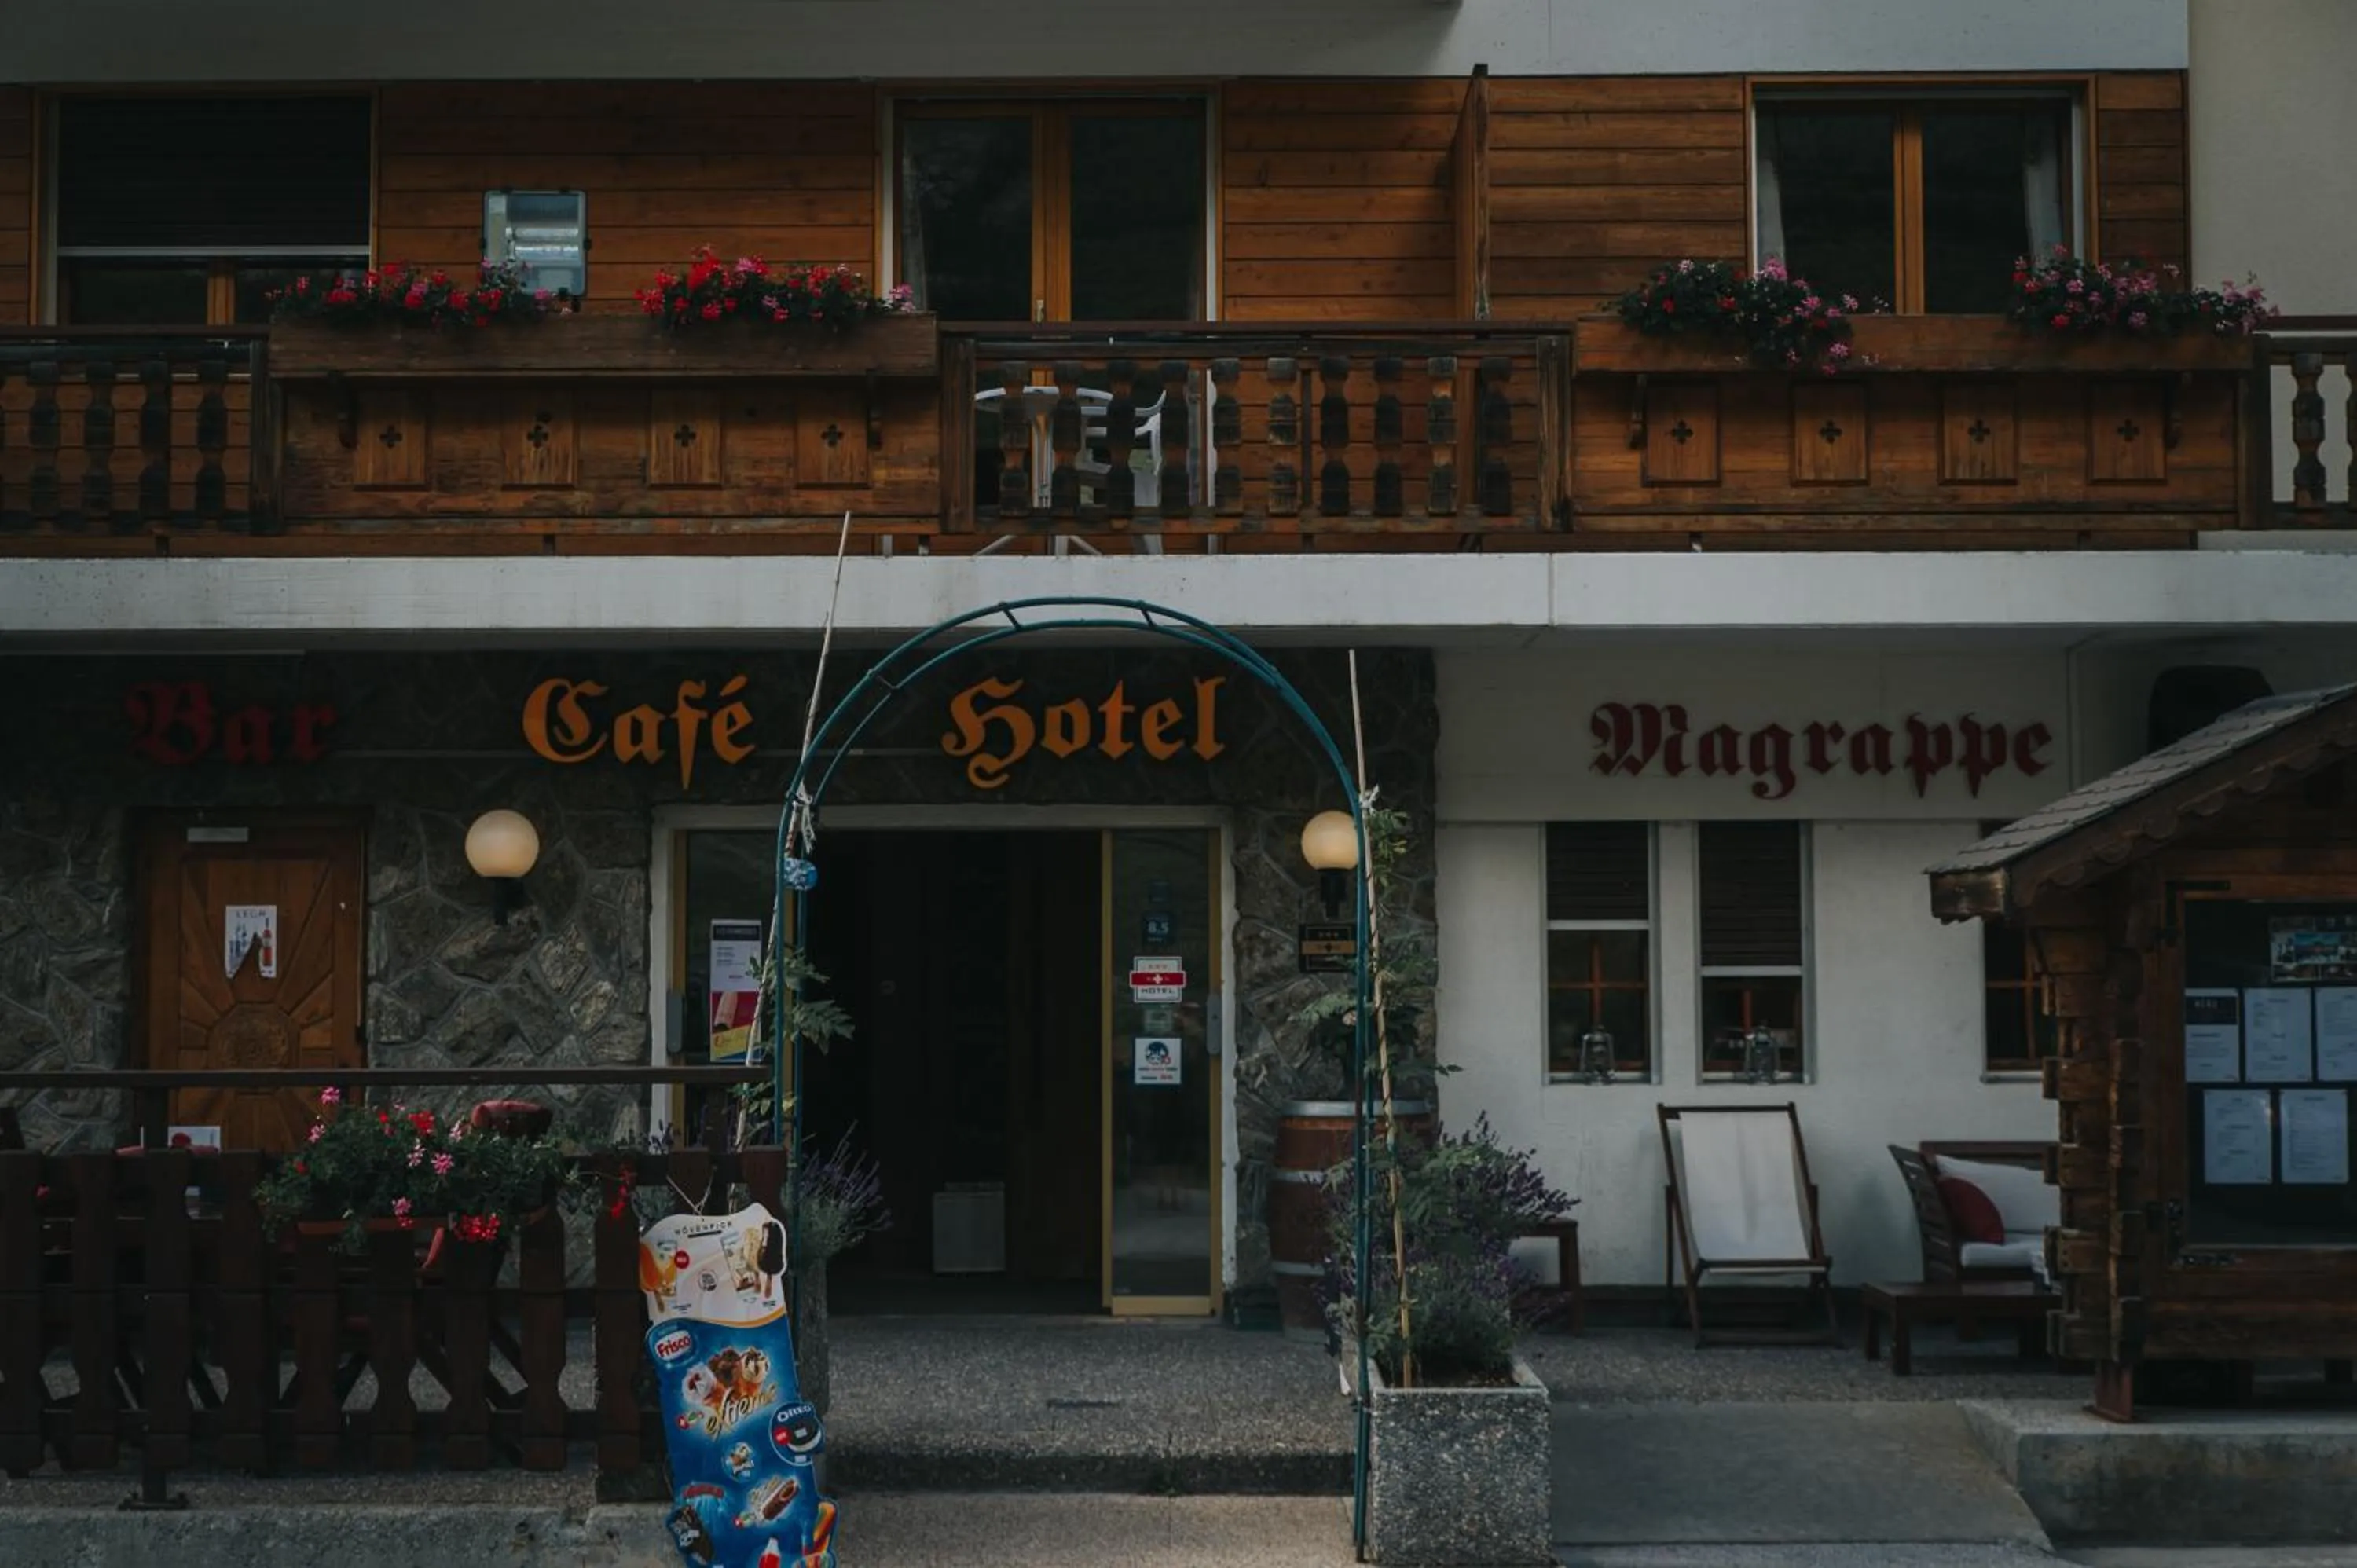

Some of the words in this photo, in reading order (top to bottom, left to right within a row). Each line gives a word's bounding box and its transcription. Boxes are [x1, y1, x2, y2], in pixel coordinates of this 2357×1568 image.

[123, 680, 338, 766] Bar
[522, 672, 757, 791] Café
[940, 675, 1227, 789] Hotel
[1589, 702, 2053, 800] Magrappe
[1141, 986, 1177, 995] HOTEL
[658, 1335, 691, 1357] Frisco
[776, 1405, 812, 1423] OREO
